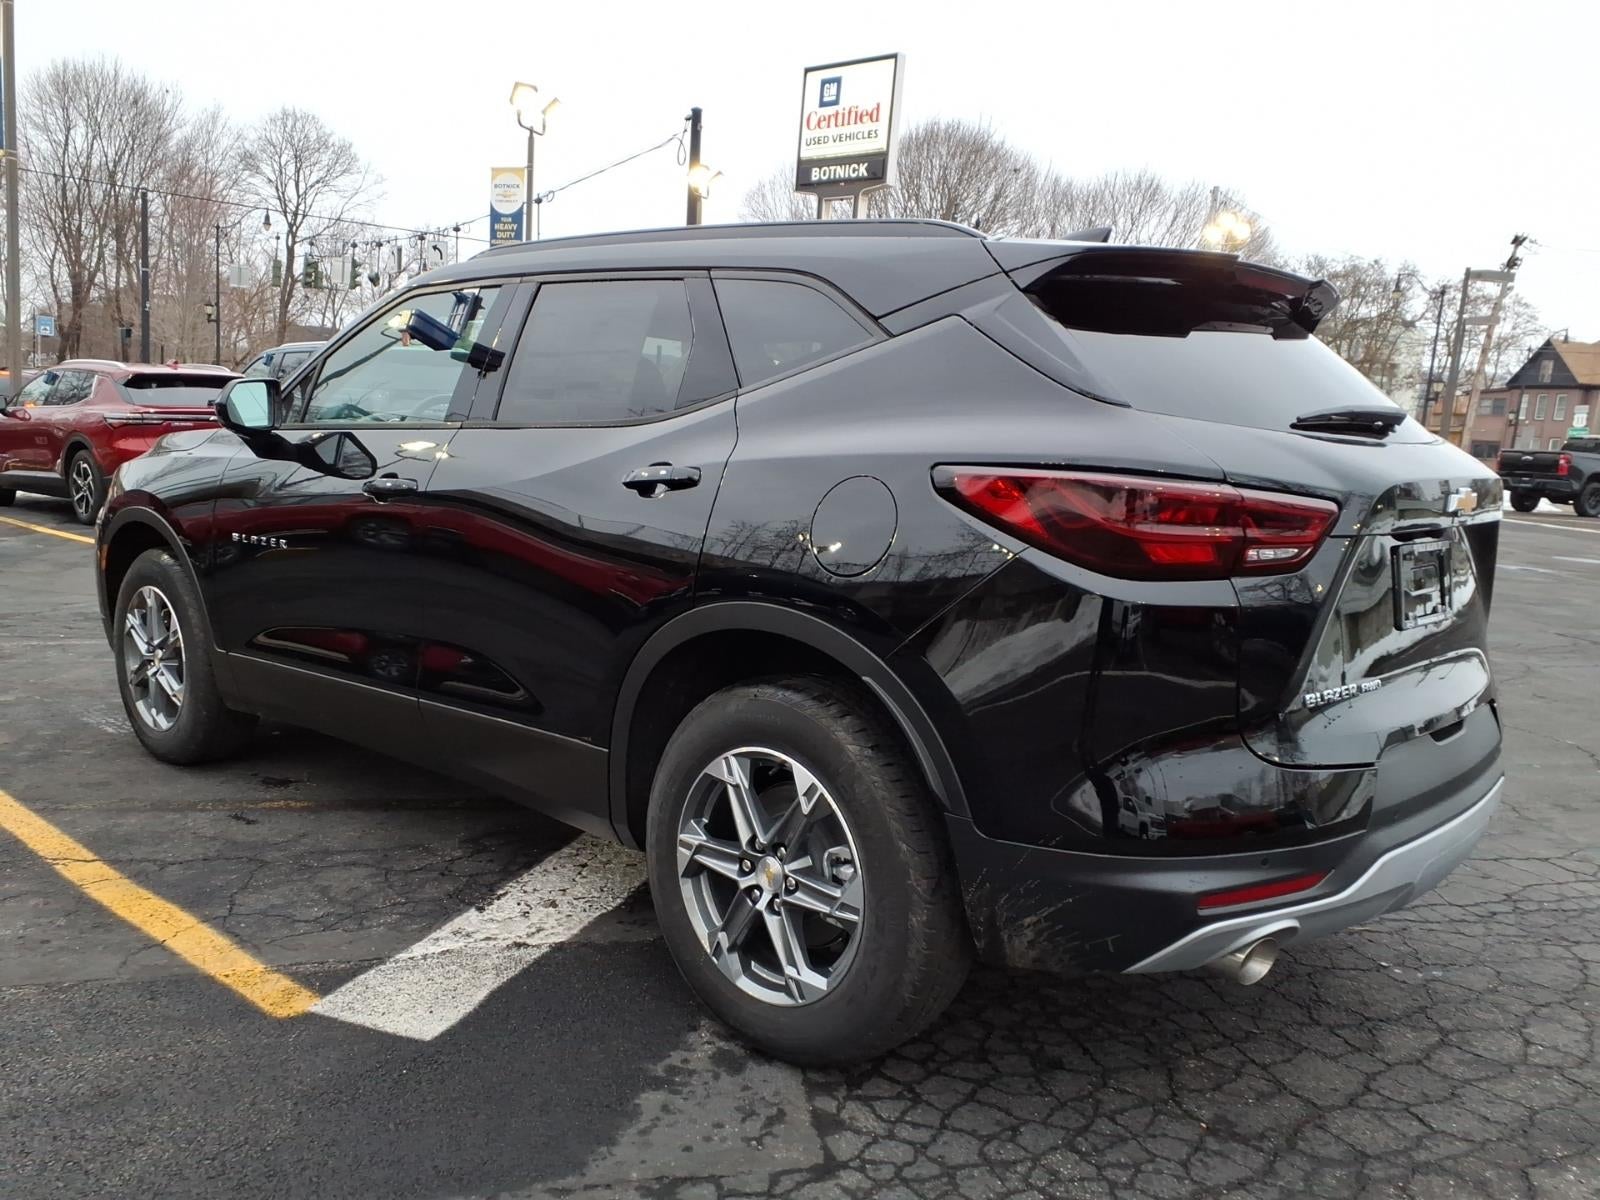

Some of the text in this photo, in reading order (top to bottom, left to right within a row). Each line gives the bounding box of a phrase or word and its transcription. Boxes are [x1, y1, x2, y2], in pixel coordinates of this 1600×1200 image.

[823, 82, 838, 97] GM
[806, 102, 881, 131] Certified
[805, 129, 879, 147] USED VEHICLES
[811, 162, 869, 181] BOTNICK
[494, 223, 518, 231] HEAVY
[496, 231, 515, 239] DUTY
[231, 532, 288, 549] BLAZER
[1304, 684, 1358, 708] BLAZER
